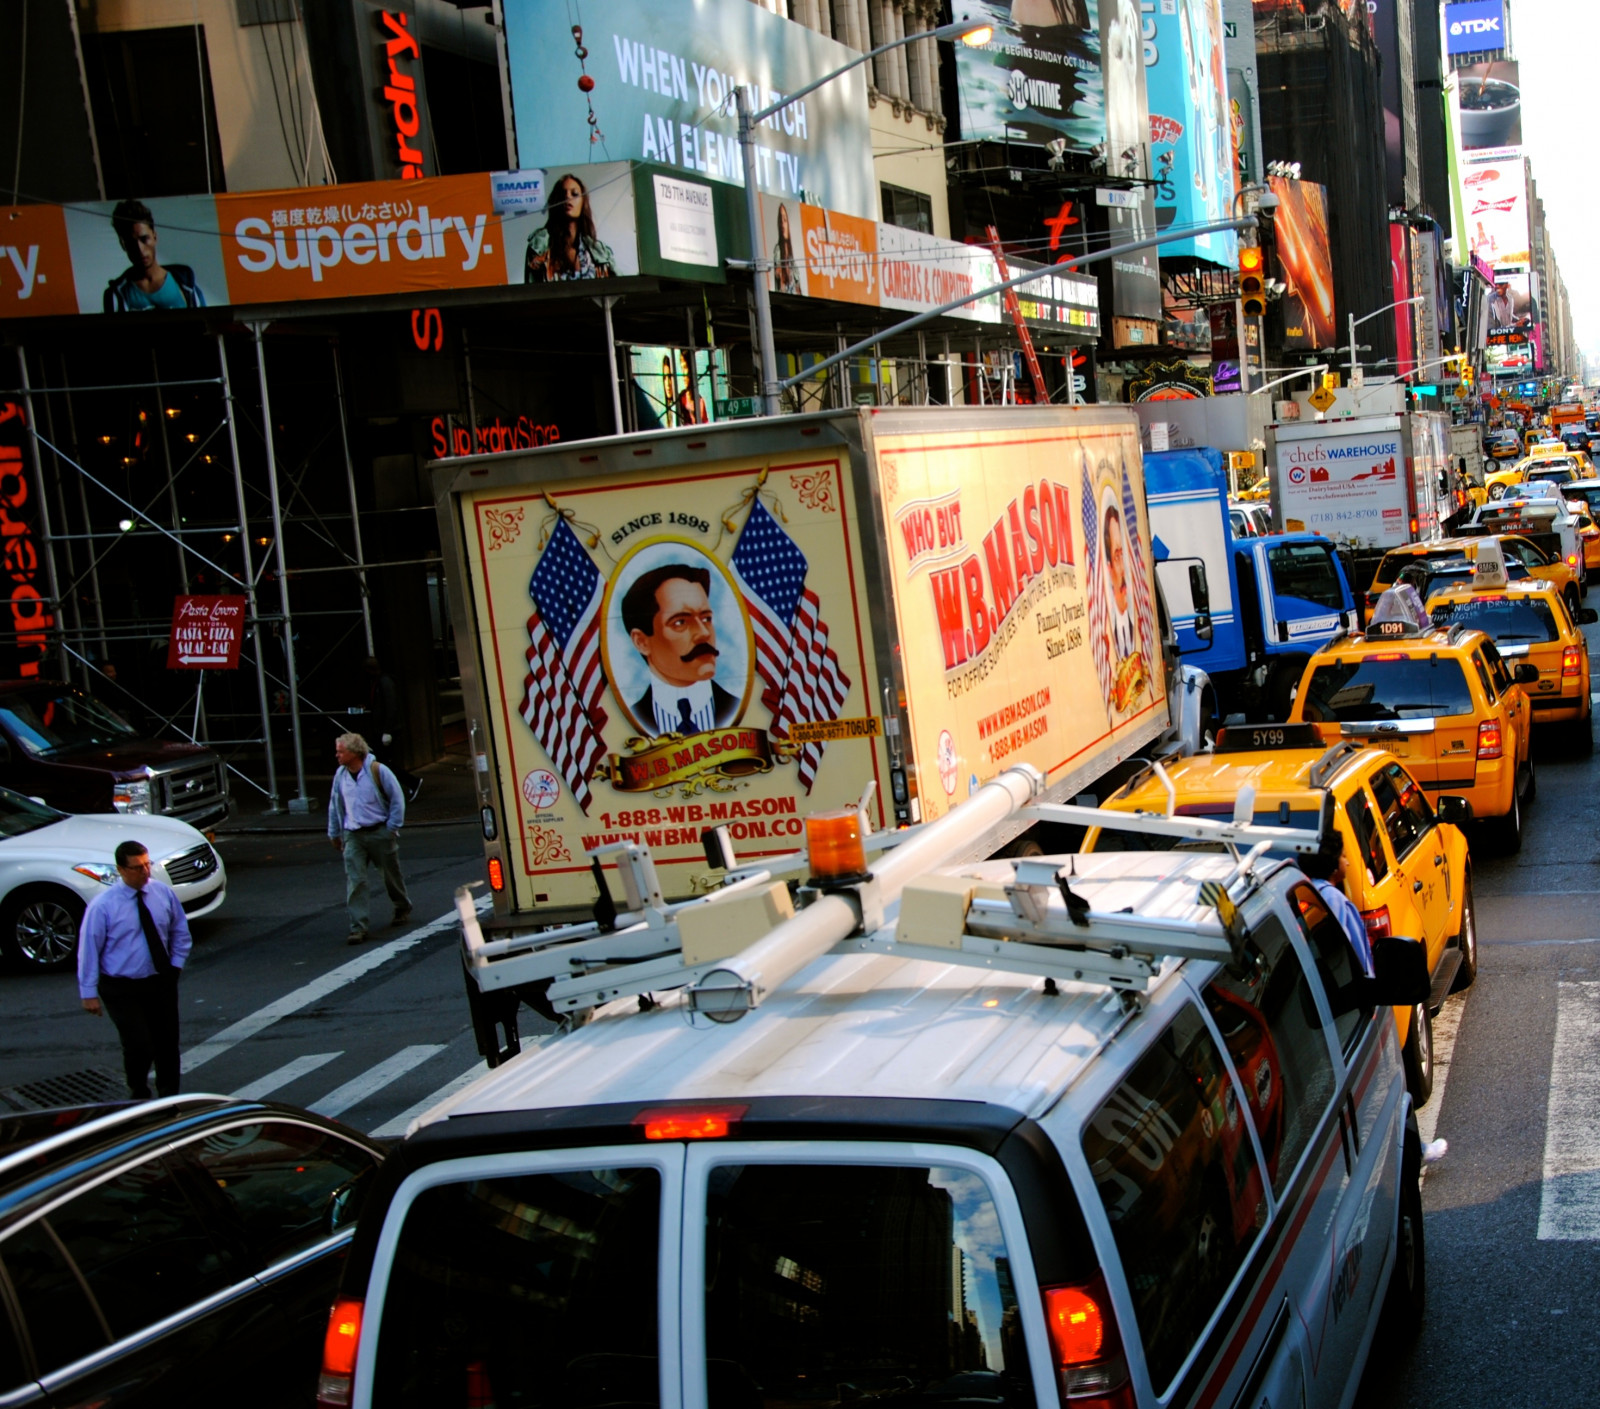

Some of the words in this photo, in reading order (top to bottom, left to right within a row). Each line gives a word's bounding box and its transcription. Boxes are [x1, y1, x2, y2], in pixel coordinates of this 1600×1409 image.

[1461, 17, 1500, 34] TDK
[979, 43, 1003, 53] STORY
[1005, 45, 1033, 59] BEGINS
[1034, 49, 1062, 65] SUNDAY
[1063, 55, 1078, 68] OCT
[613, 34, 688, 102] WHEN
[692, 61, 738, 117] YOU
[1008, 69, 1062, 110] SHOWTIME
[642, 113, 676, 165] AN
[680, 123, 771, 188] ELEMT
[496, 181, 539, 191] SMART
[686, 189, 709, 207] AVENUE
[882, 257, 922, 304] CAMERAS
[924, 268, 931, 304] &
[1490, 327, 1515, 336] SONY
[716, 401, 725, 416] W
[728, 401, 739, 415] 49
[741, 400, 750, 408] ST
[1290, 443, 1327, 463] chefs
[1327, 443, 1397, 459] WAREHOUSE
[1308, 484, 1342, 494] Dairyland
[611, 512, 662, 545] SINCE
[668, 511, 710, 533] 1898
[1310, 512, 1334, 524] (718)
[1336, 509, 1378, 520] 842-8700
[1501, 522, 1534, 531] KNAK
[901, 508, 935, 561] WHO
[936, 501, 963, 548] BUT
[929, 477, 1076, 671] W.B.MASON
[178, 598, 209, 620] Pasta
[209, 600, 239, 621] Lovers
[1036, 606, 1061, 634] Family
[1061, 596, 1085, 625] Owned
[1454, 602, 1482, 613] NIGHT
[176, 627, 203, 640] PASTA
[209, 627, 235, 640] PIZZA
[947, 676, 964, 700] FOR
[964, 658, 989, 692] OFFICE
[1016, 578, 1047, 621] FURNITURE
[1052, 570, 1077, 590] PRINTING
[1380, 622, 1404, 634] 1D91
[178, 641, 206, 655] SALAD
[212, 641, 230, 655] BAR
[1045, 635, 1066, 660] Since
[1066, 626, 1083, 651] 1898
[977, 686, 1052, 741] WWW.WBMASON.COM
[844, 719, 877, 736] 706UR
[988, 714, 1049, 764] 1-888-WB-MASON
[1252, 729, 1285, 746] 5Y99
[630, 731, 756, 781] W.B.MASON
[600, 796, 797, 830] 1-888-WB-MASON
